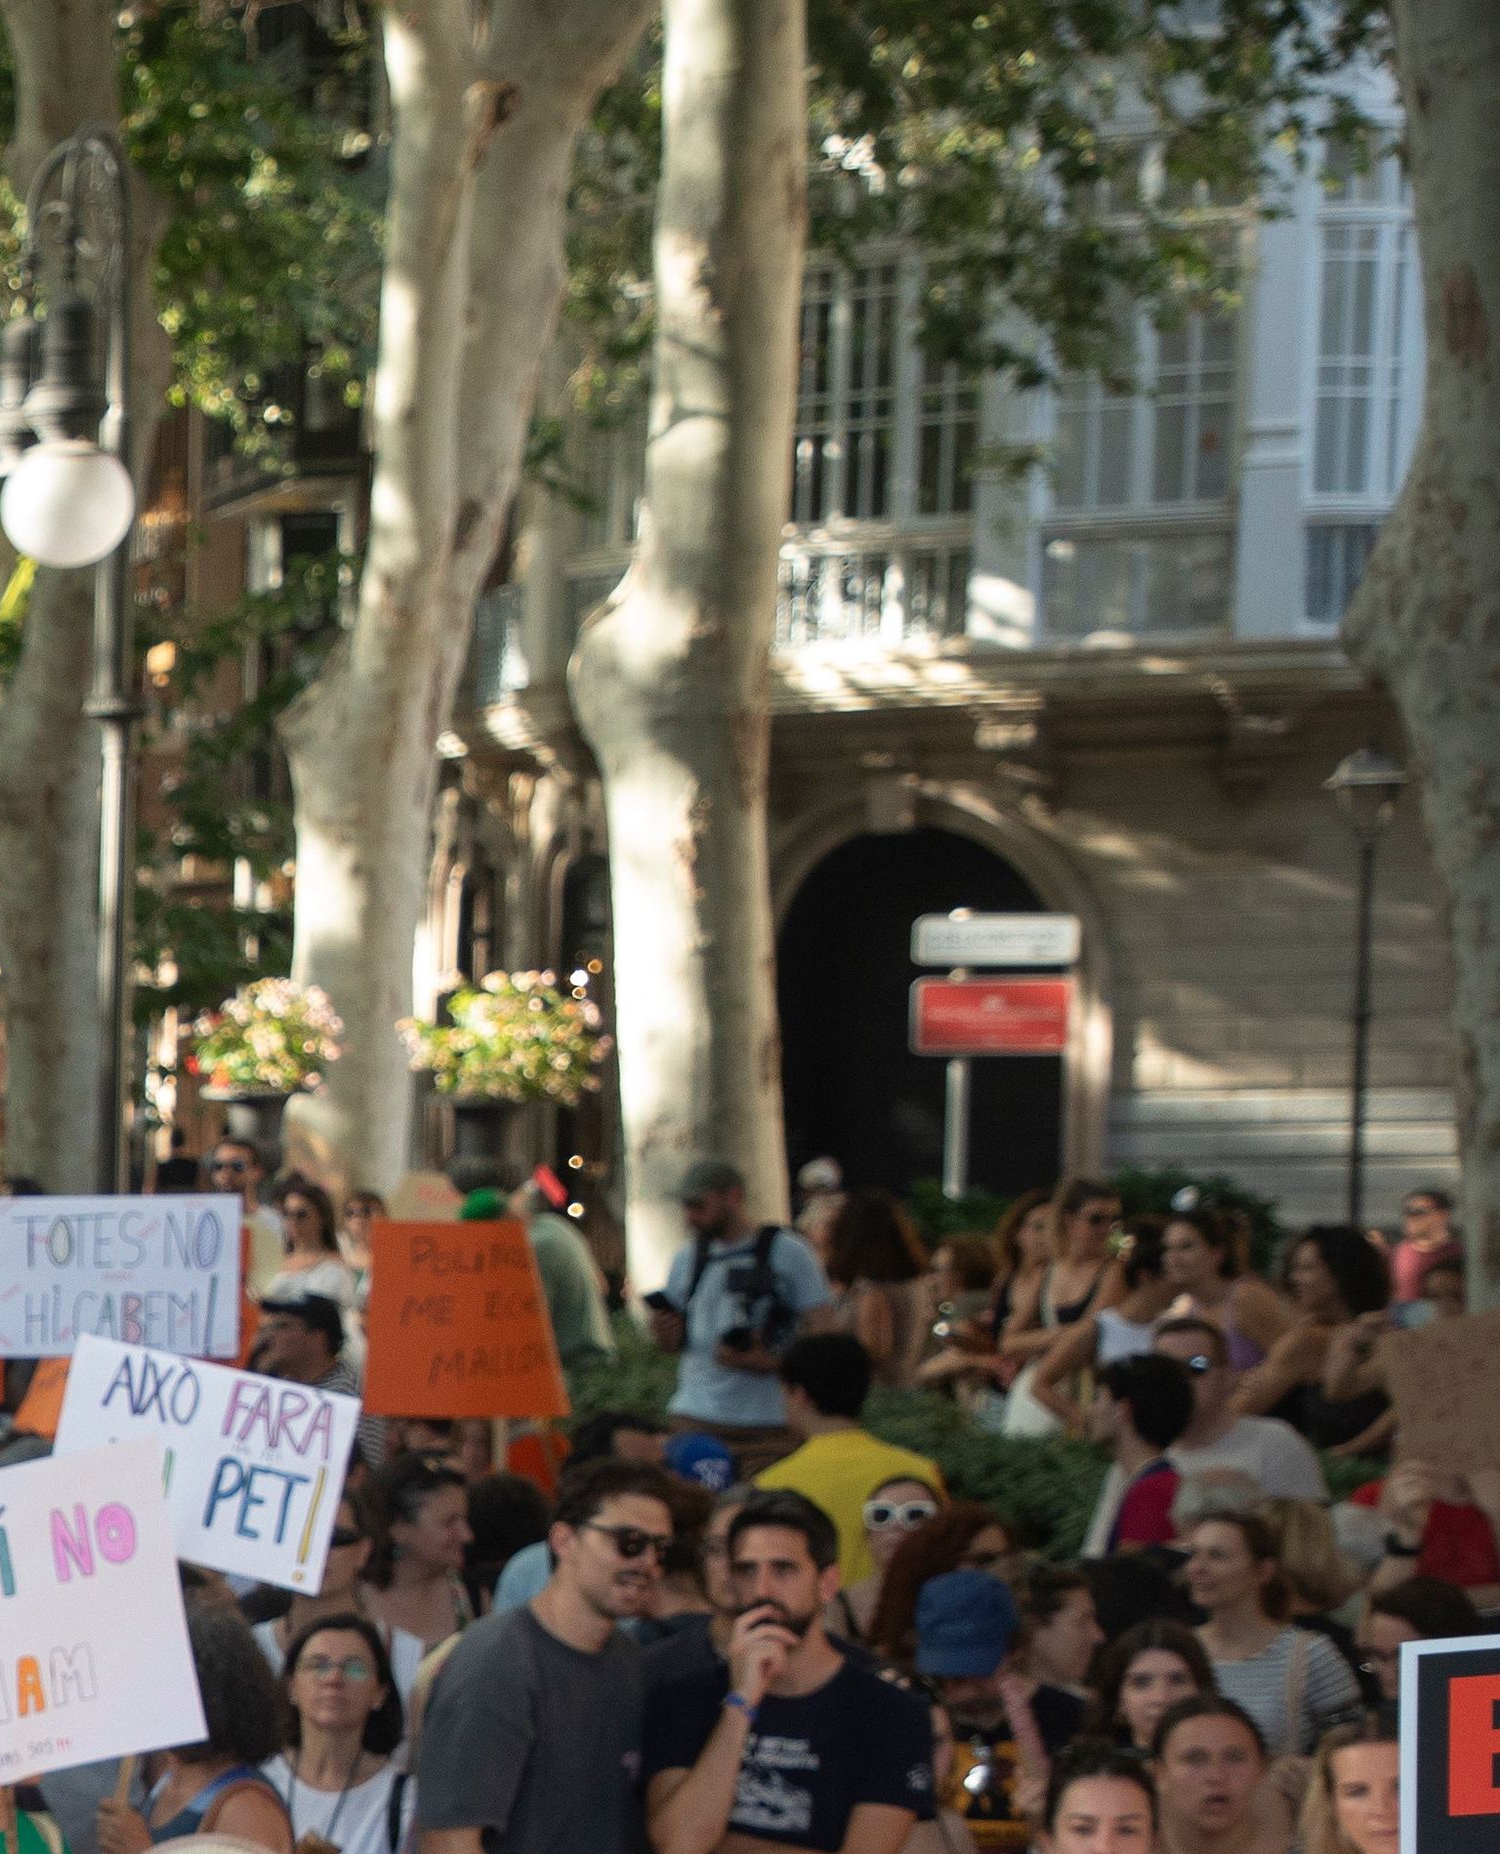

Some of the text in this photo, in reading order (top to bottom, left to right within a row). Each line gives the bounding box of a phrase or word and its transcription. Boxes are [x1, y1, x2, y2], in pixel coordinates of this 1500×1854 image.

[12, 1210, 224, 1271] TOTES NO
[101, 1354, 334, 1461] AIXÒ FARÀ
[49, 1502, 137, 1584] NO
